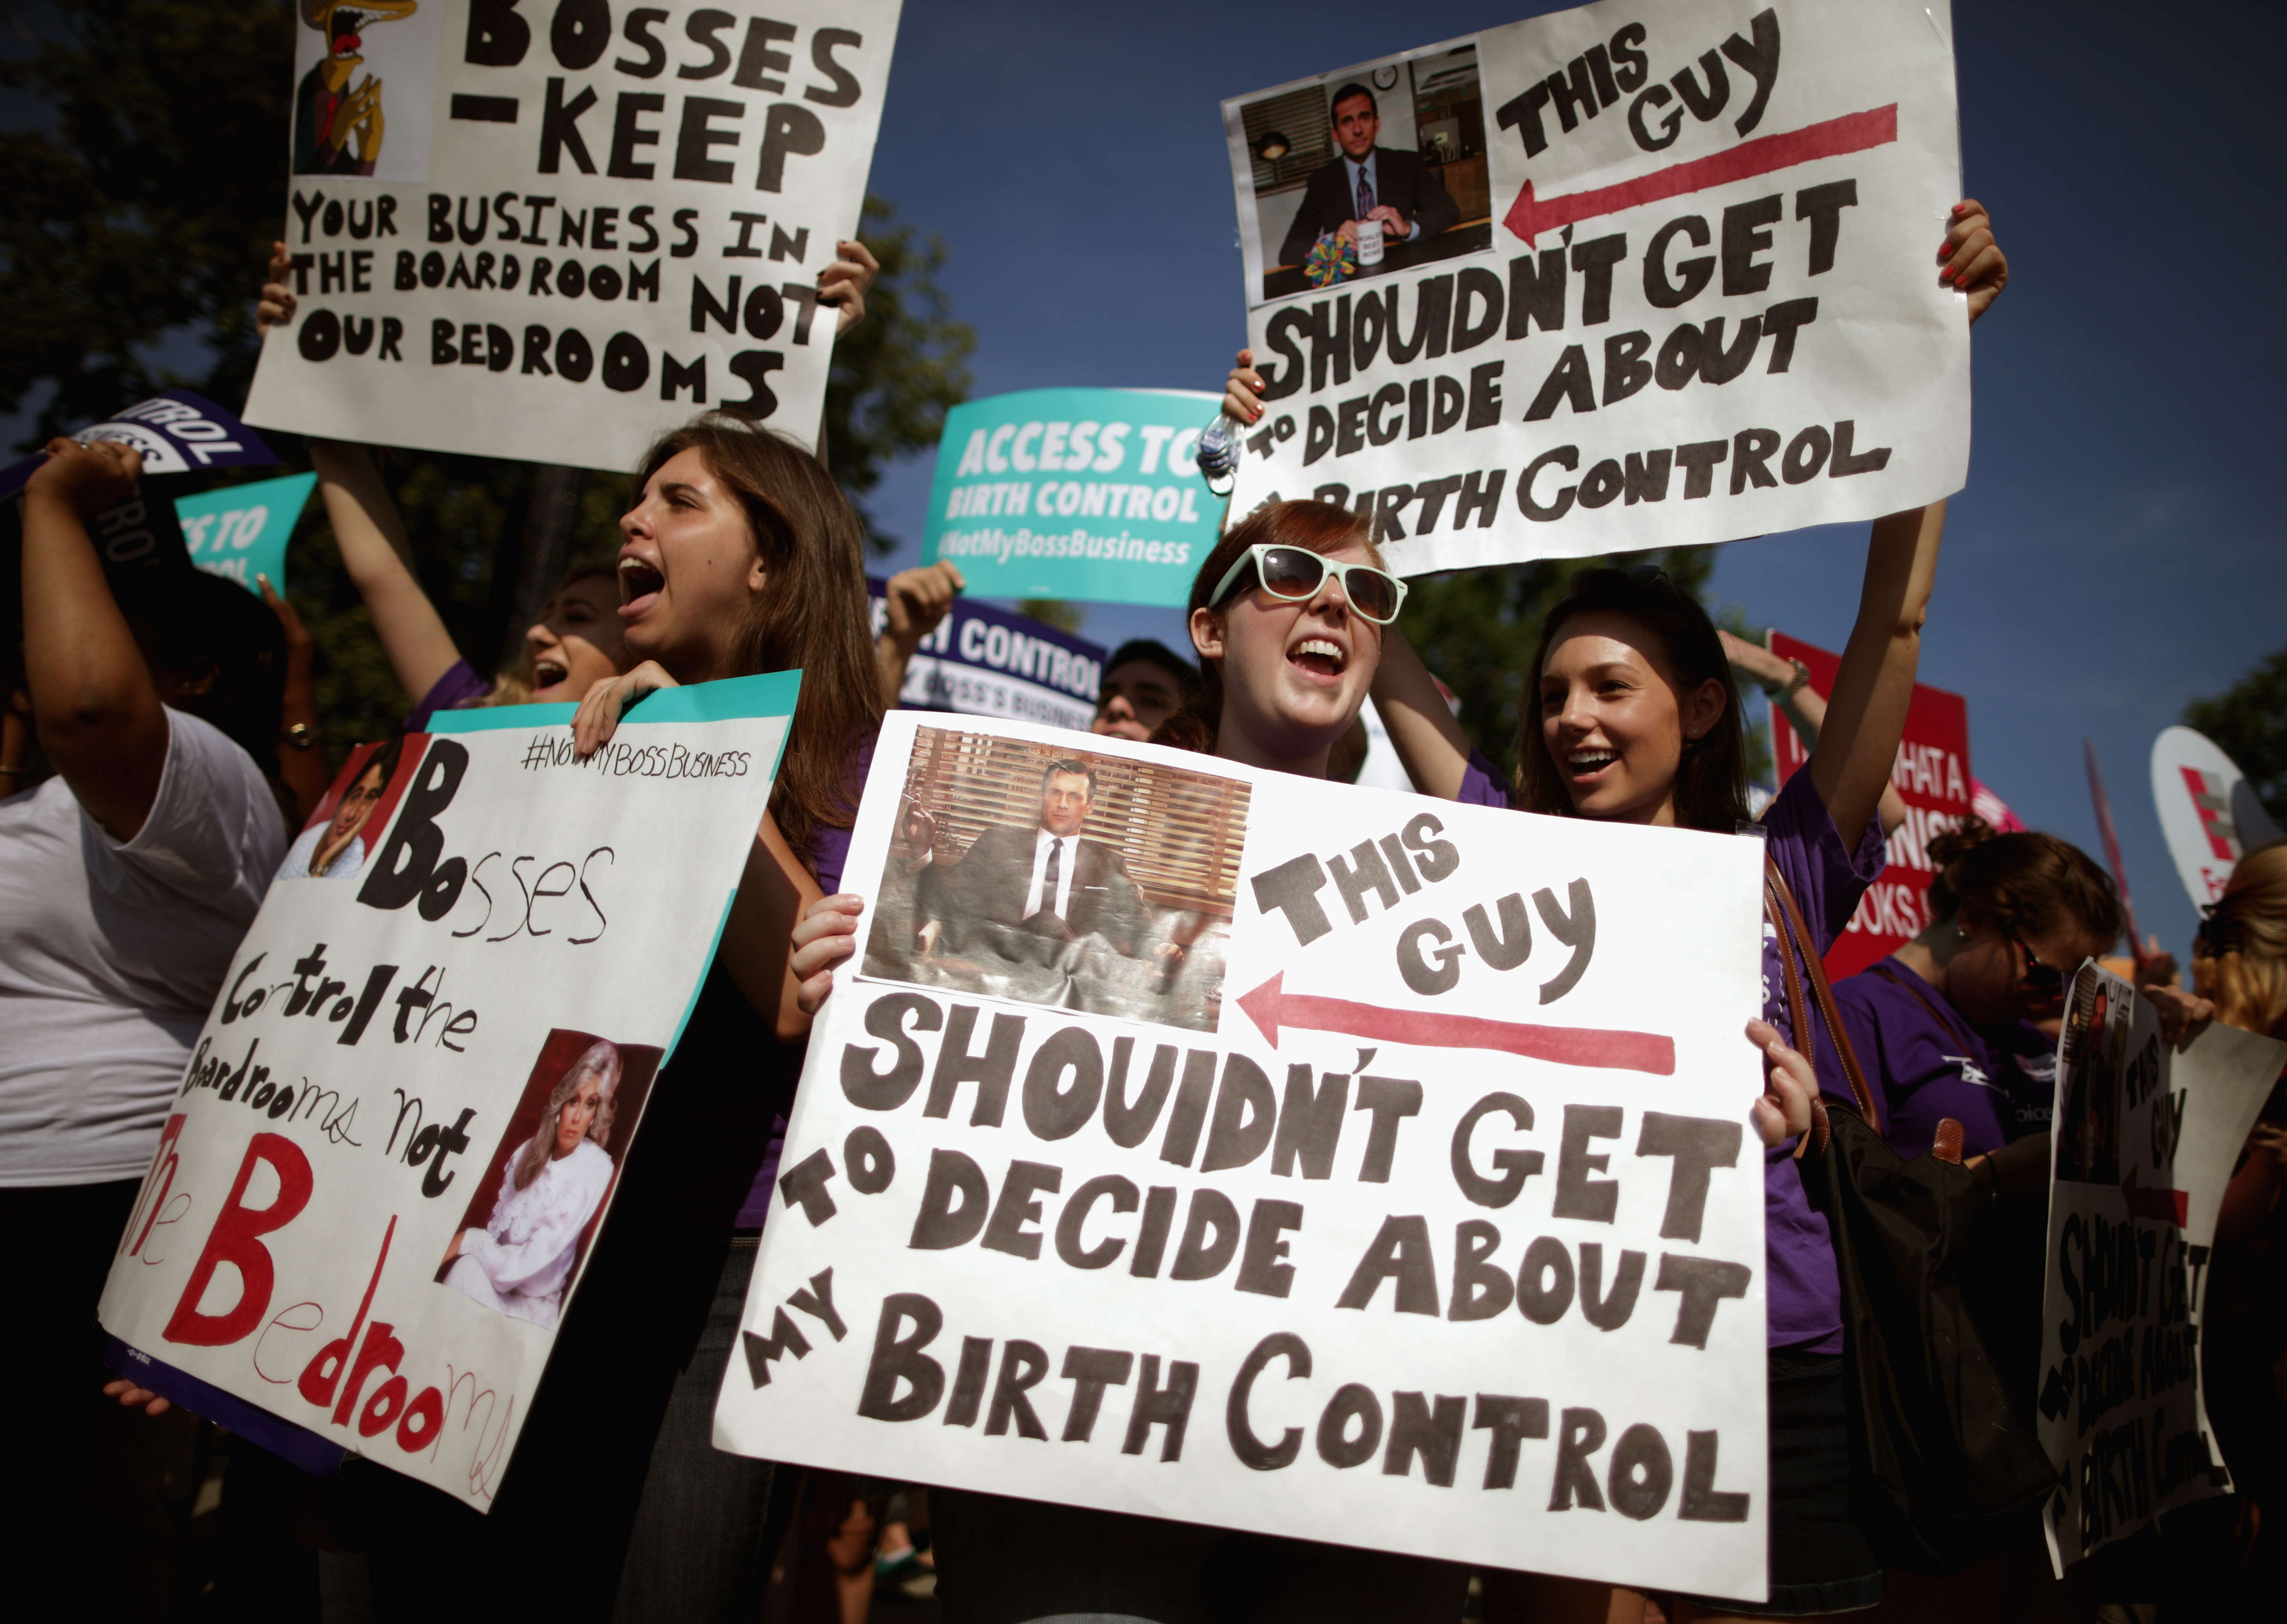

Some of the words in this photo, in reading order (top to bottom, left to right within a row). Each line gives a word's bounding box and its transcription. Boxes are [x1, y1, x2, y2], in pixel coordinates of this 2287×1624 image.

[465, 0, 862, 108] BOSSES
[1497, 22, 1648, 159] THIS
[1629, 7, 1780, 153] GUY
[293, 190, 397, 243] YOUR
[428, 192, 699, 258] BUSINESS
[722, 211, 810, 265] IN
[1644, 179, 1856, 309] GET
[291, 250, 373, 296] THE
[394, 250, 660, 302] BOARDROOM
[691, 274, 822, 346] NOT
[297, 308, 403, 362] OUR
[431, 318, 784, 421] BEDROOMS
[1247, 415, 1296, 460] TO
[1303, 360, 1504, 467] DECIDE
[1523, 297, 1817, 422] ABOUT
[945, 481, 1031, 521] BIRTH
[1036, 481, 1199, 523] CONTROL
[956, 421, 1131, 477] ACCESS
[1139, 425, 1204, 477] TO
[1516, 420, 1891, 522] CONTROL
[210, 504, 268, 552] TO
[958, 617, 1103, 701] CONTROL
[1947, 753, 1968, 804] A
[356, 739, 614, 944] Bosses
[1252, 812, 1459, 946] THIS
[220, 944, 398, 1046] Control
[393, 965, 477, 1052] the
[1396, 877, 1596, 1005] GUY
[181, 1037, 361, 1146] Boardrooms
[386, 1088, 477, 1198] not
[1451, 1091, 1741, 1243] GET
[779, 1125, 895, 1226] TO
[909, 1147, 1304, 1298] DECIDE
[1335, 1213, 1751, 1350] ABOUT
[2160, 1225, 2210, 1327] GET
[120, 1114, 191, 1265] The
[162, 1132, 514, 1499] Bedrooms
[742, 1267, 846, 1390] MY
[857, 1293, 1198, 1463] BIRTH
[1227, 1331, 1749, 1522] CONTROL
